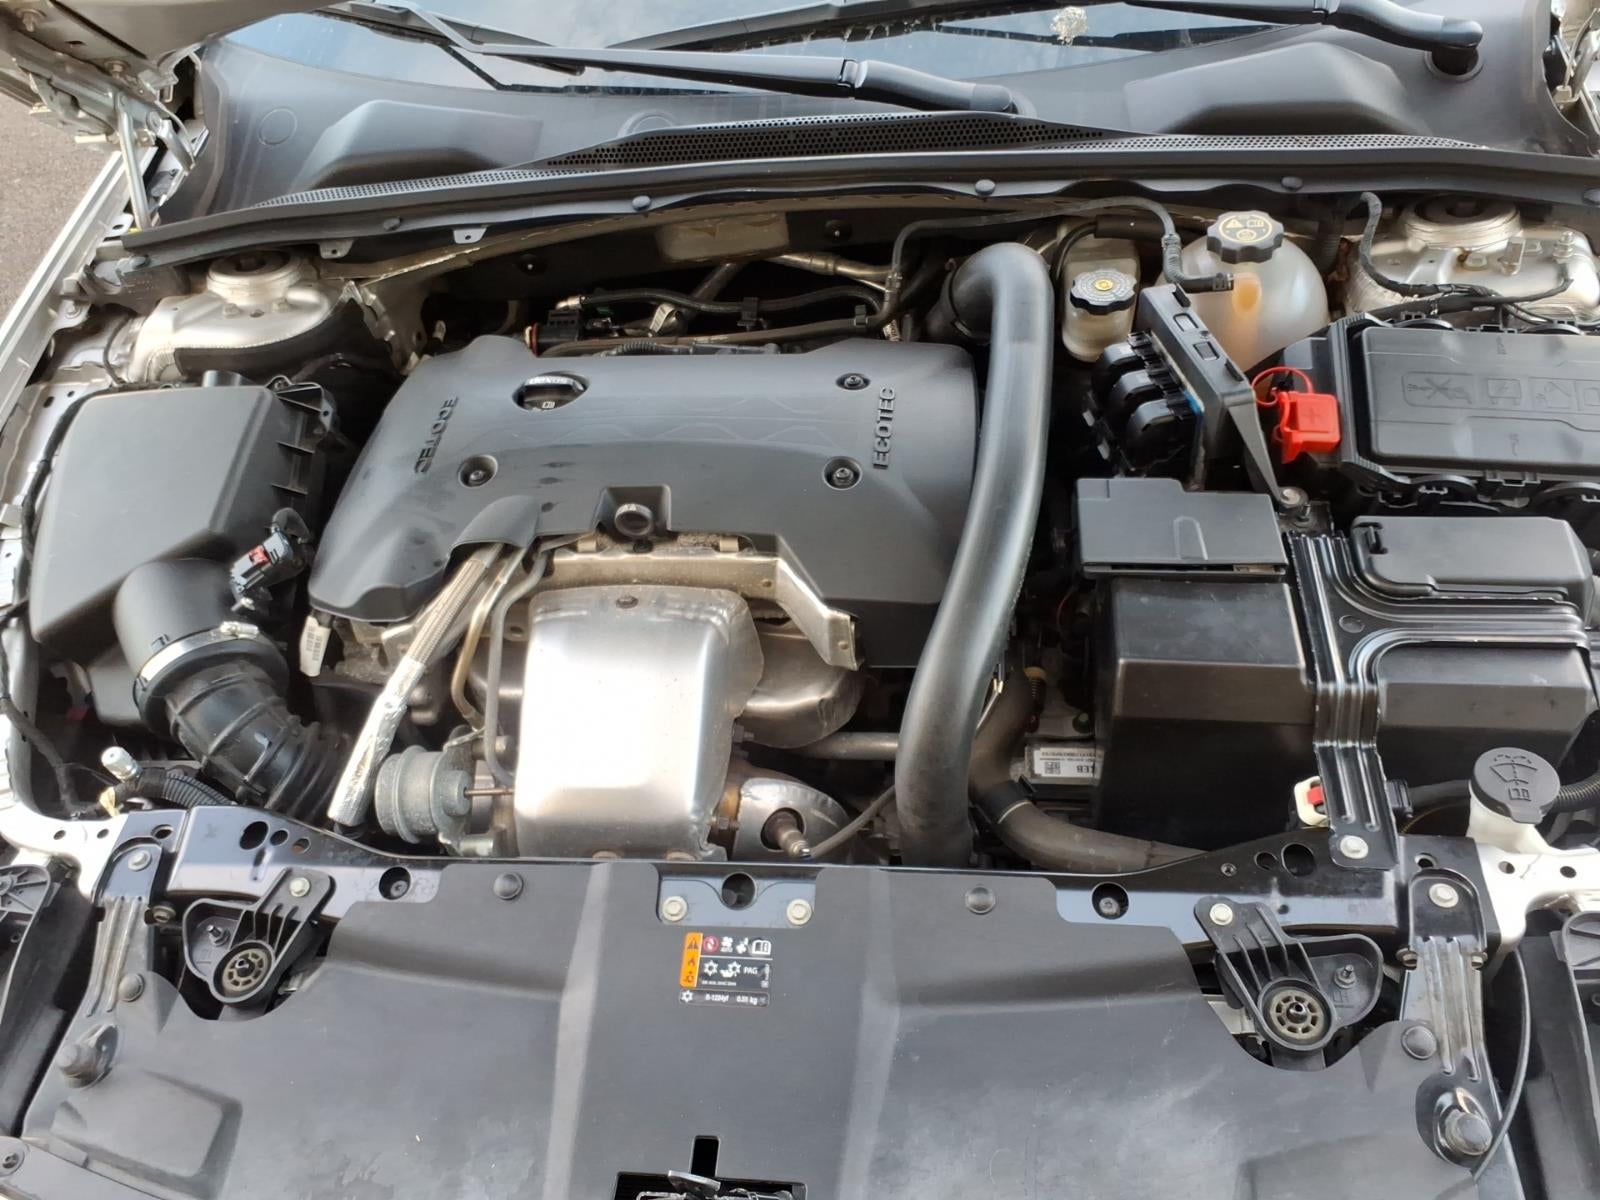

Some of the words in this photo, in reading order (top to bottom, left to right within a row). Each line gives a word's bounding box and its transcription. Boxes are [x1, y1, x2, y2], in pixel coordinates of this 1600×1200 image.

[414, 397, 458, 473] ECOTEC
[873, 387, 895, 469] ECOTEC
[744, 966, 758, 975] PAG
[750, 996, 758, 1005] kg
